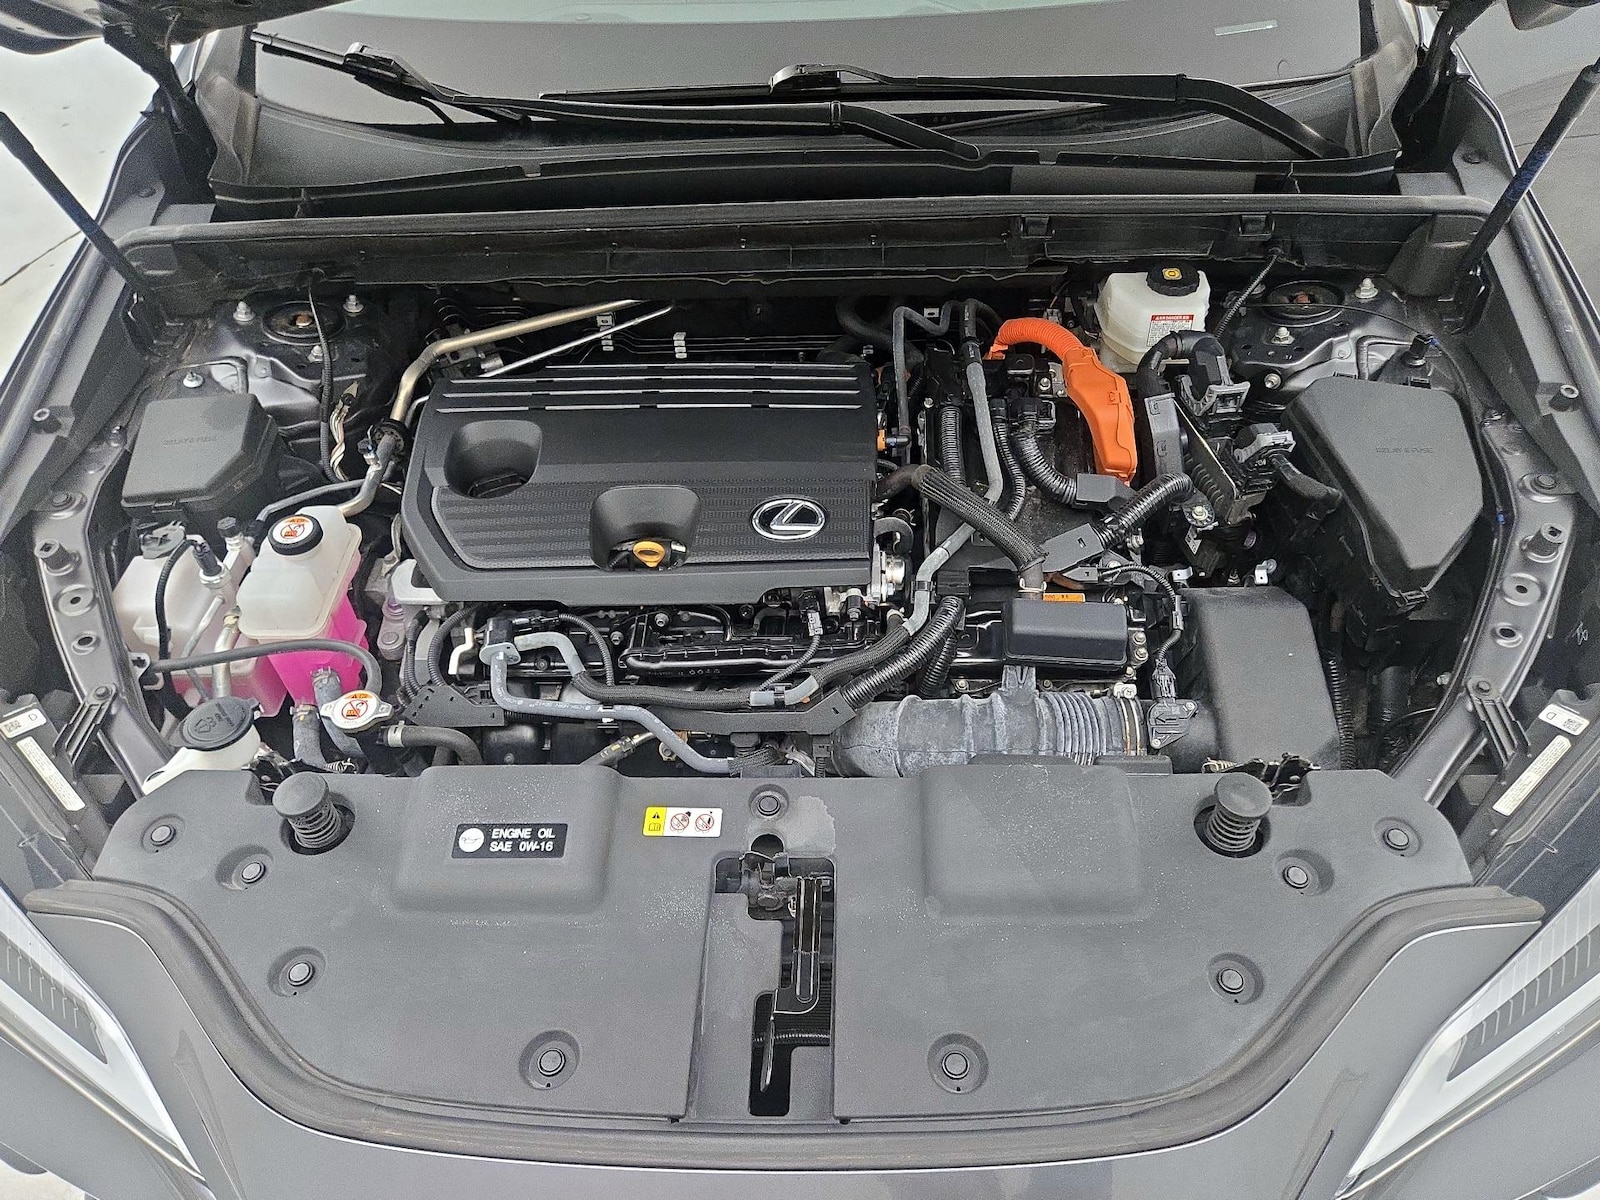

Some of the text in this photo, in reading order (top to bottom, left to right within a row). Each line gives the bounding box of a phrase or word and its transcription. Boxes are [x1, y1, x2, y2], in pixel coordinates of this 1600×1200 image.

[491, 828, 556, 839] ENGINE OIL
[489, 841, 553, 852] SAE 0W-16
